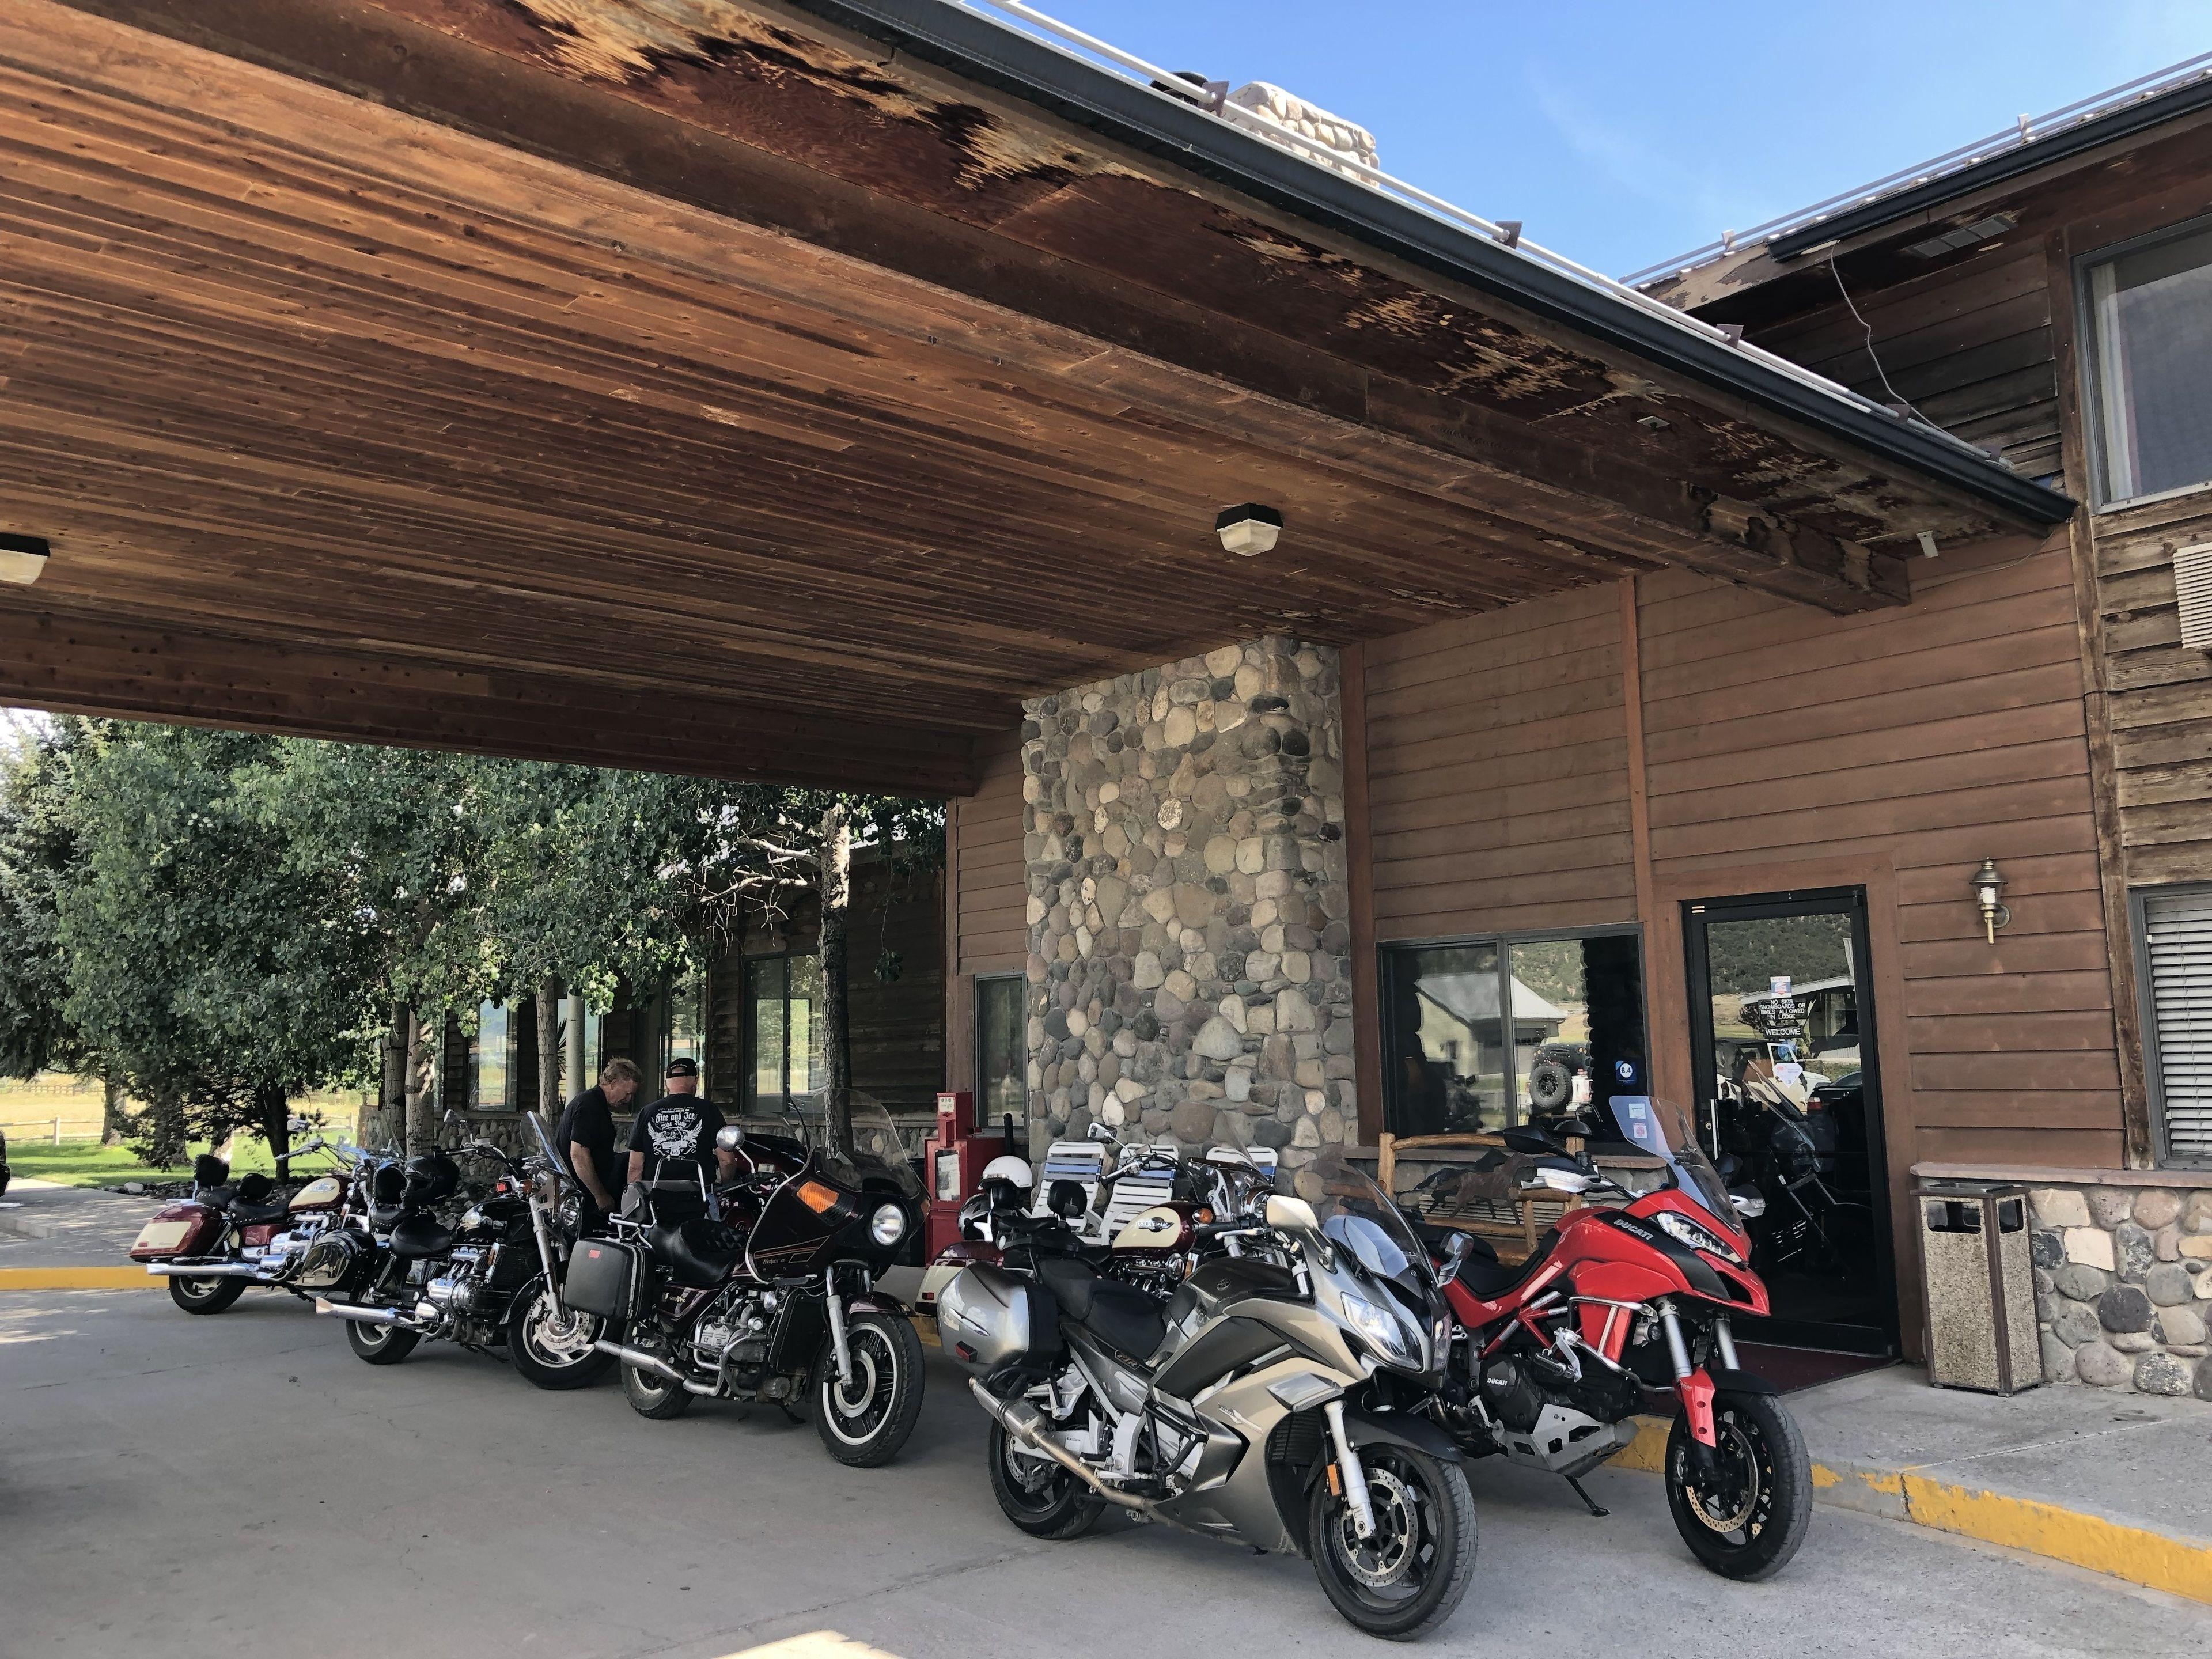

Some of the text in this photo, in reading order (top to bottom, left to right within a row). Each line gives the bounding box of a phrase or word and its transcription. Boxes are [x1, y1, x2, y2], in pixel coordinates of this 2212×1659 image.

[1765, 1028, 1801, 1036] WELCOME
[671, 1112, 682, 1121] and
[1613, 1218, 1654, 1240] DUCATI
[1487, 1377, 1508, 1386] DUCATI
